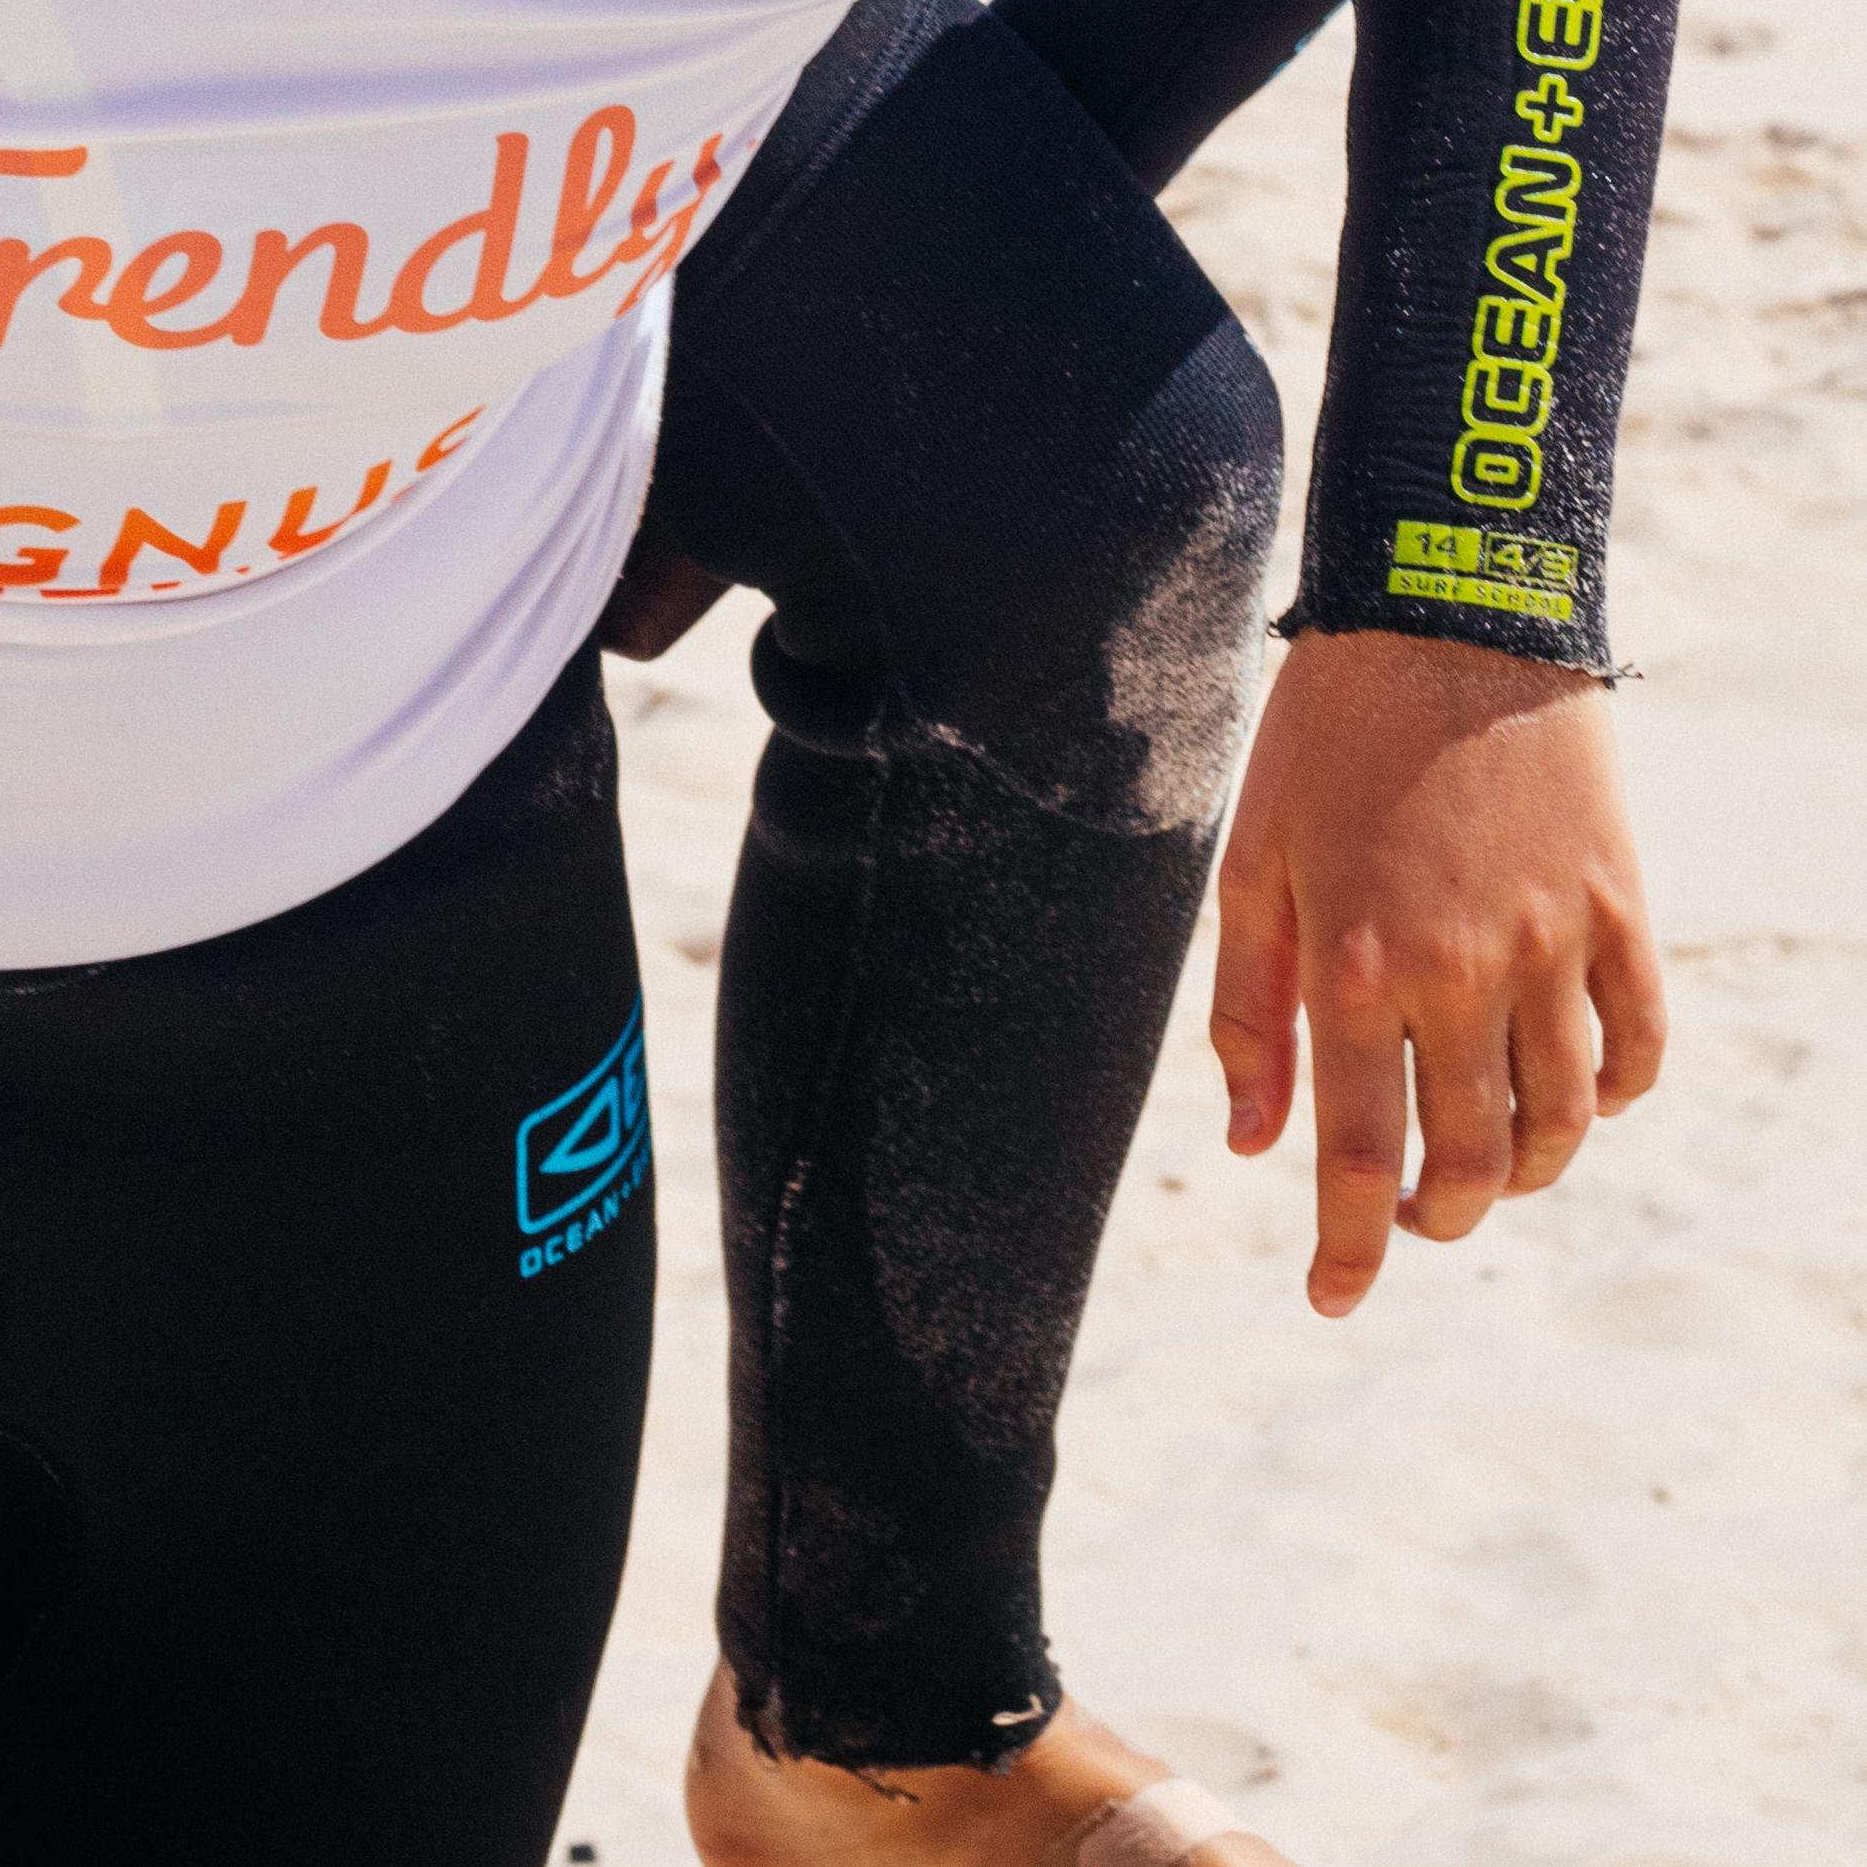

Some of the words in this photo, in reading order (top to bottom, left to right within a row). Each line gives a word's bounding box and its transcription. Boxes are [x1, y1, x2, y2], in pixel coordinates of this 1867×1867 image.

[1416, 531, 1458, 558] 14
[1399, 574, 1464, 595] SURF
[518, 1189, 620, 1278] OCEAN
